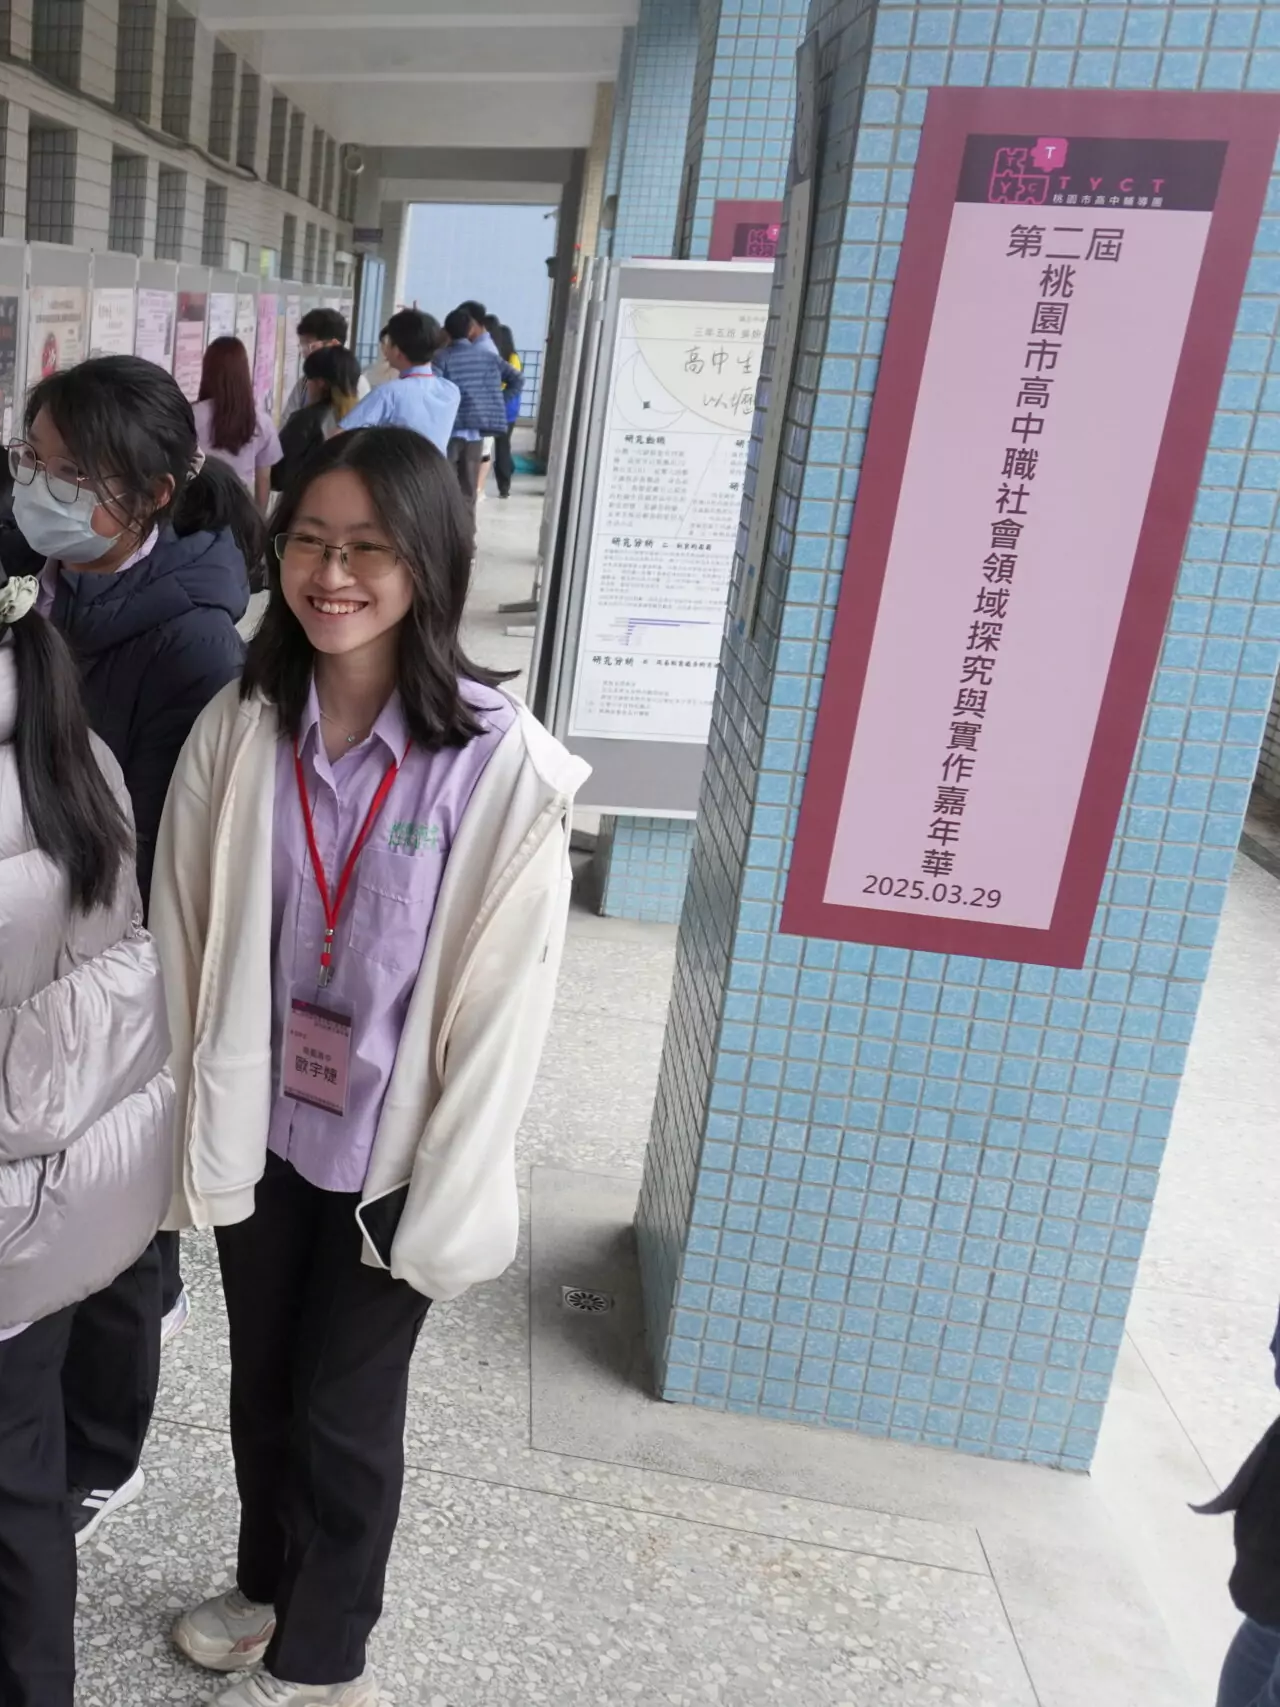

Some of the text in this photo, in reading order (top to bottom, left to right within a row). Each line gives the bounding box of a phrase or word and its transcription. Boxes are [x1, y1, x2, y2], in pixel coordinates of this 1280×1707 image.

[1005, 223, 1125, 263] 第二屆
[684, 344, 752, 375] 高中生
[921, 263, 1076, 878] 桃園市高中職社會領域探究與實作嘉年華
[862, 874, 1002, 909] 2025.03.29
